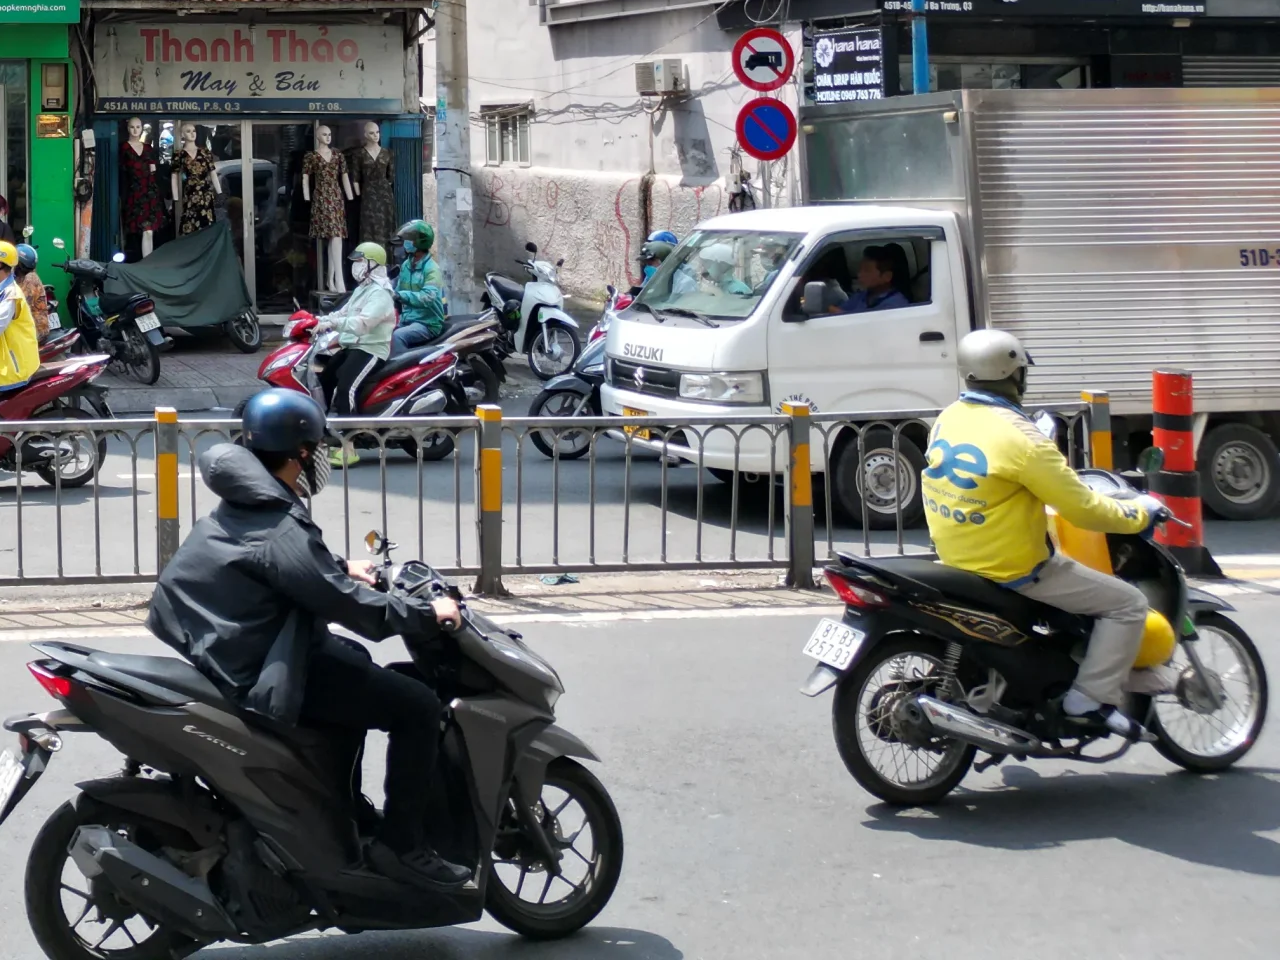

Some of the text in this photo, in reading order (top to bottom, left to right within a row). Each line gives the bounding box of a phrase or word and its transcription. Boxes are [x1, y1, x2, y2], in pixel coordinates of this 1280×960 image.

[963, 2, 972, 10] Q3
[140, 26, 359, 63] Thanh Thảo
[831, 36, 880, 52] hana hana
[181, 70, 321, 95] May & Bán
[816, 90, 840, 101] HOTLINE
[103, 101, 128, 111] 451A
[131, 101, 147, 111] HAI
[224, 101, 240, 111] Q.3
[308, 101, 325, 111] ĐT:
[624, 343, 664, 362] SUZUKI
